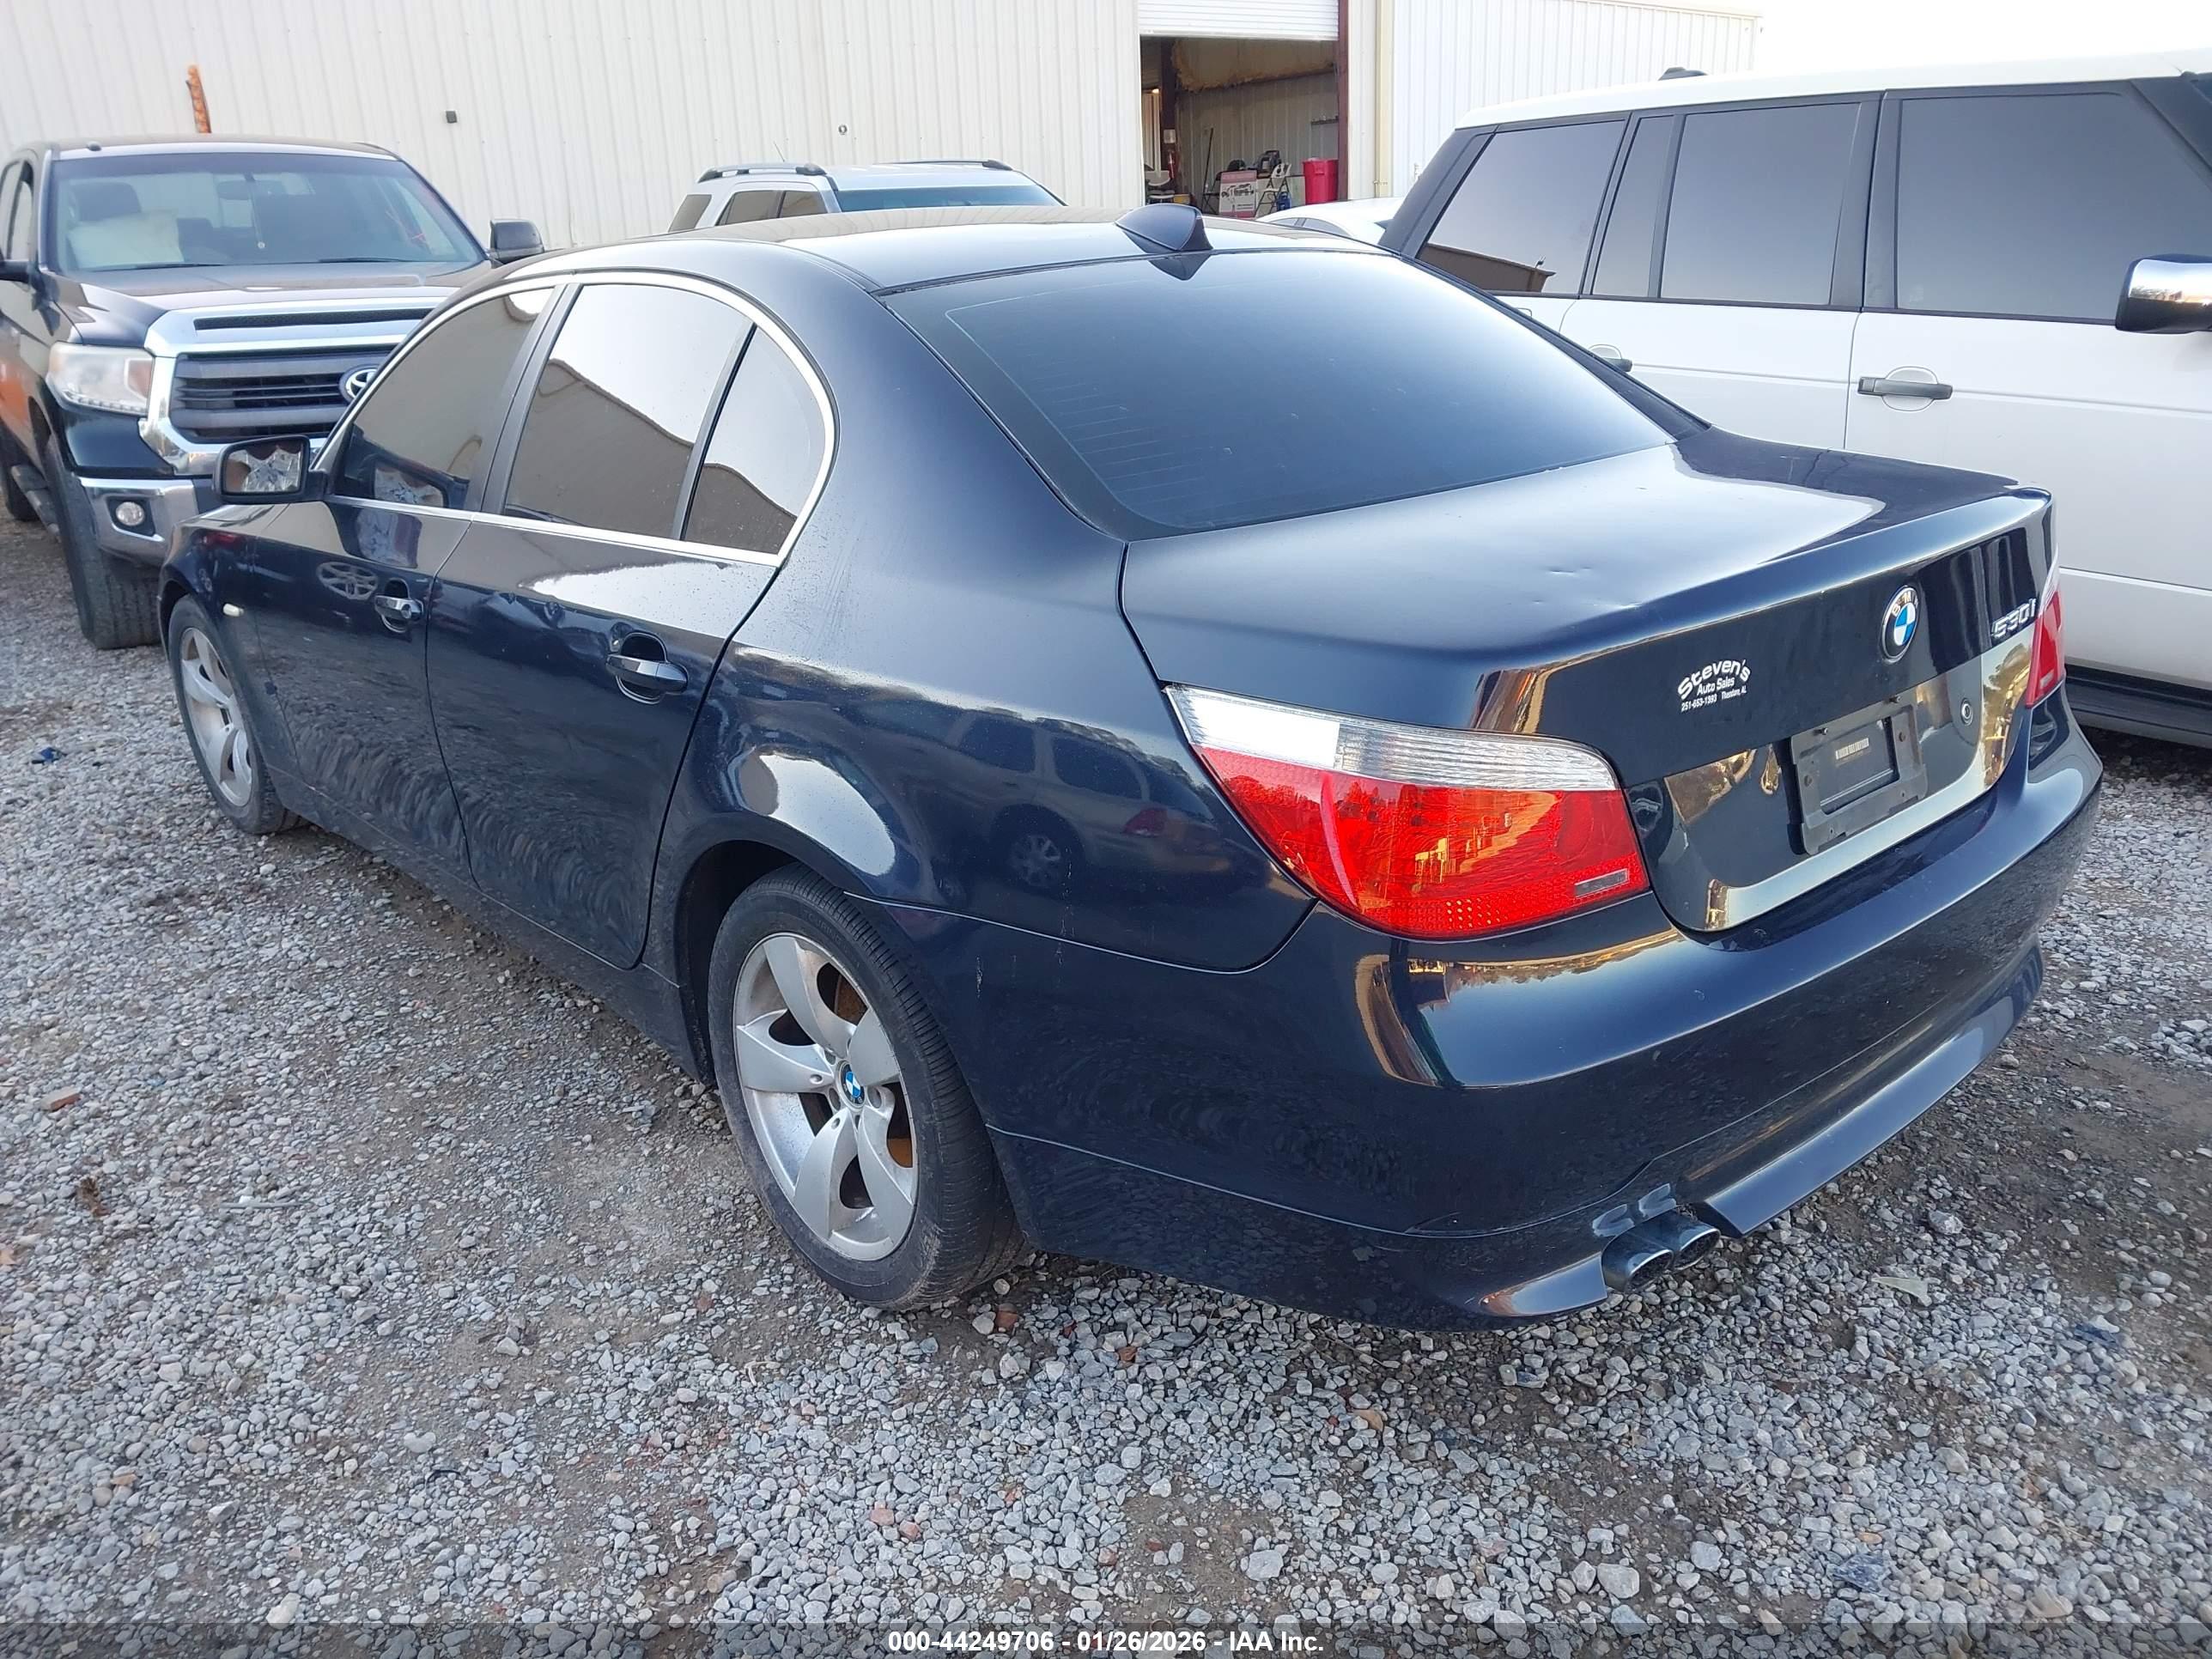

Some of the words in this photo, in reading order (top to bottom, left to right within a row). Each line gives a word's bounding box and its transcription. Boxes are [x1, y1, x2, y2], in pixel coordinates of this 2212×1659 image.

[1991, 598, 2036, 638] 530i
[1677, 659, 1751, 700] Steven's
[1696, 683, 1716, 696] Auto
[1717, 676, 1735, 690] Sales
